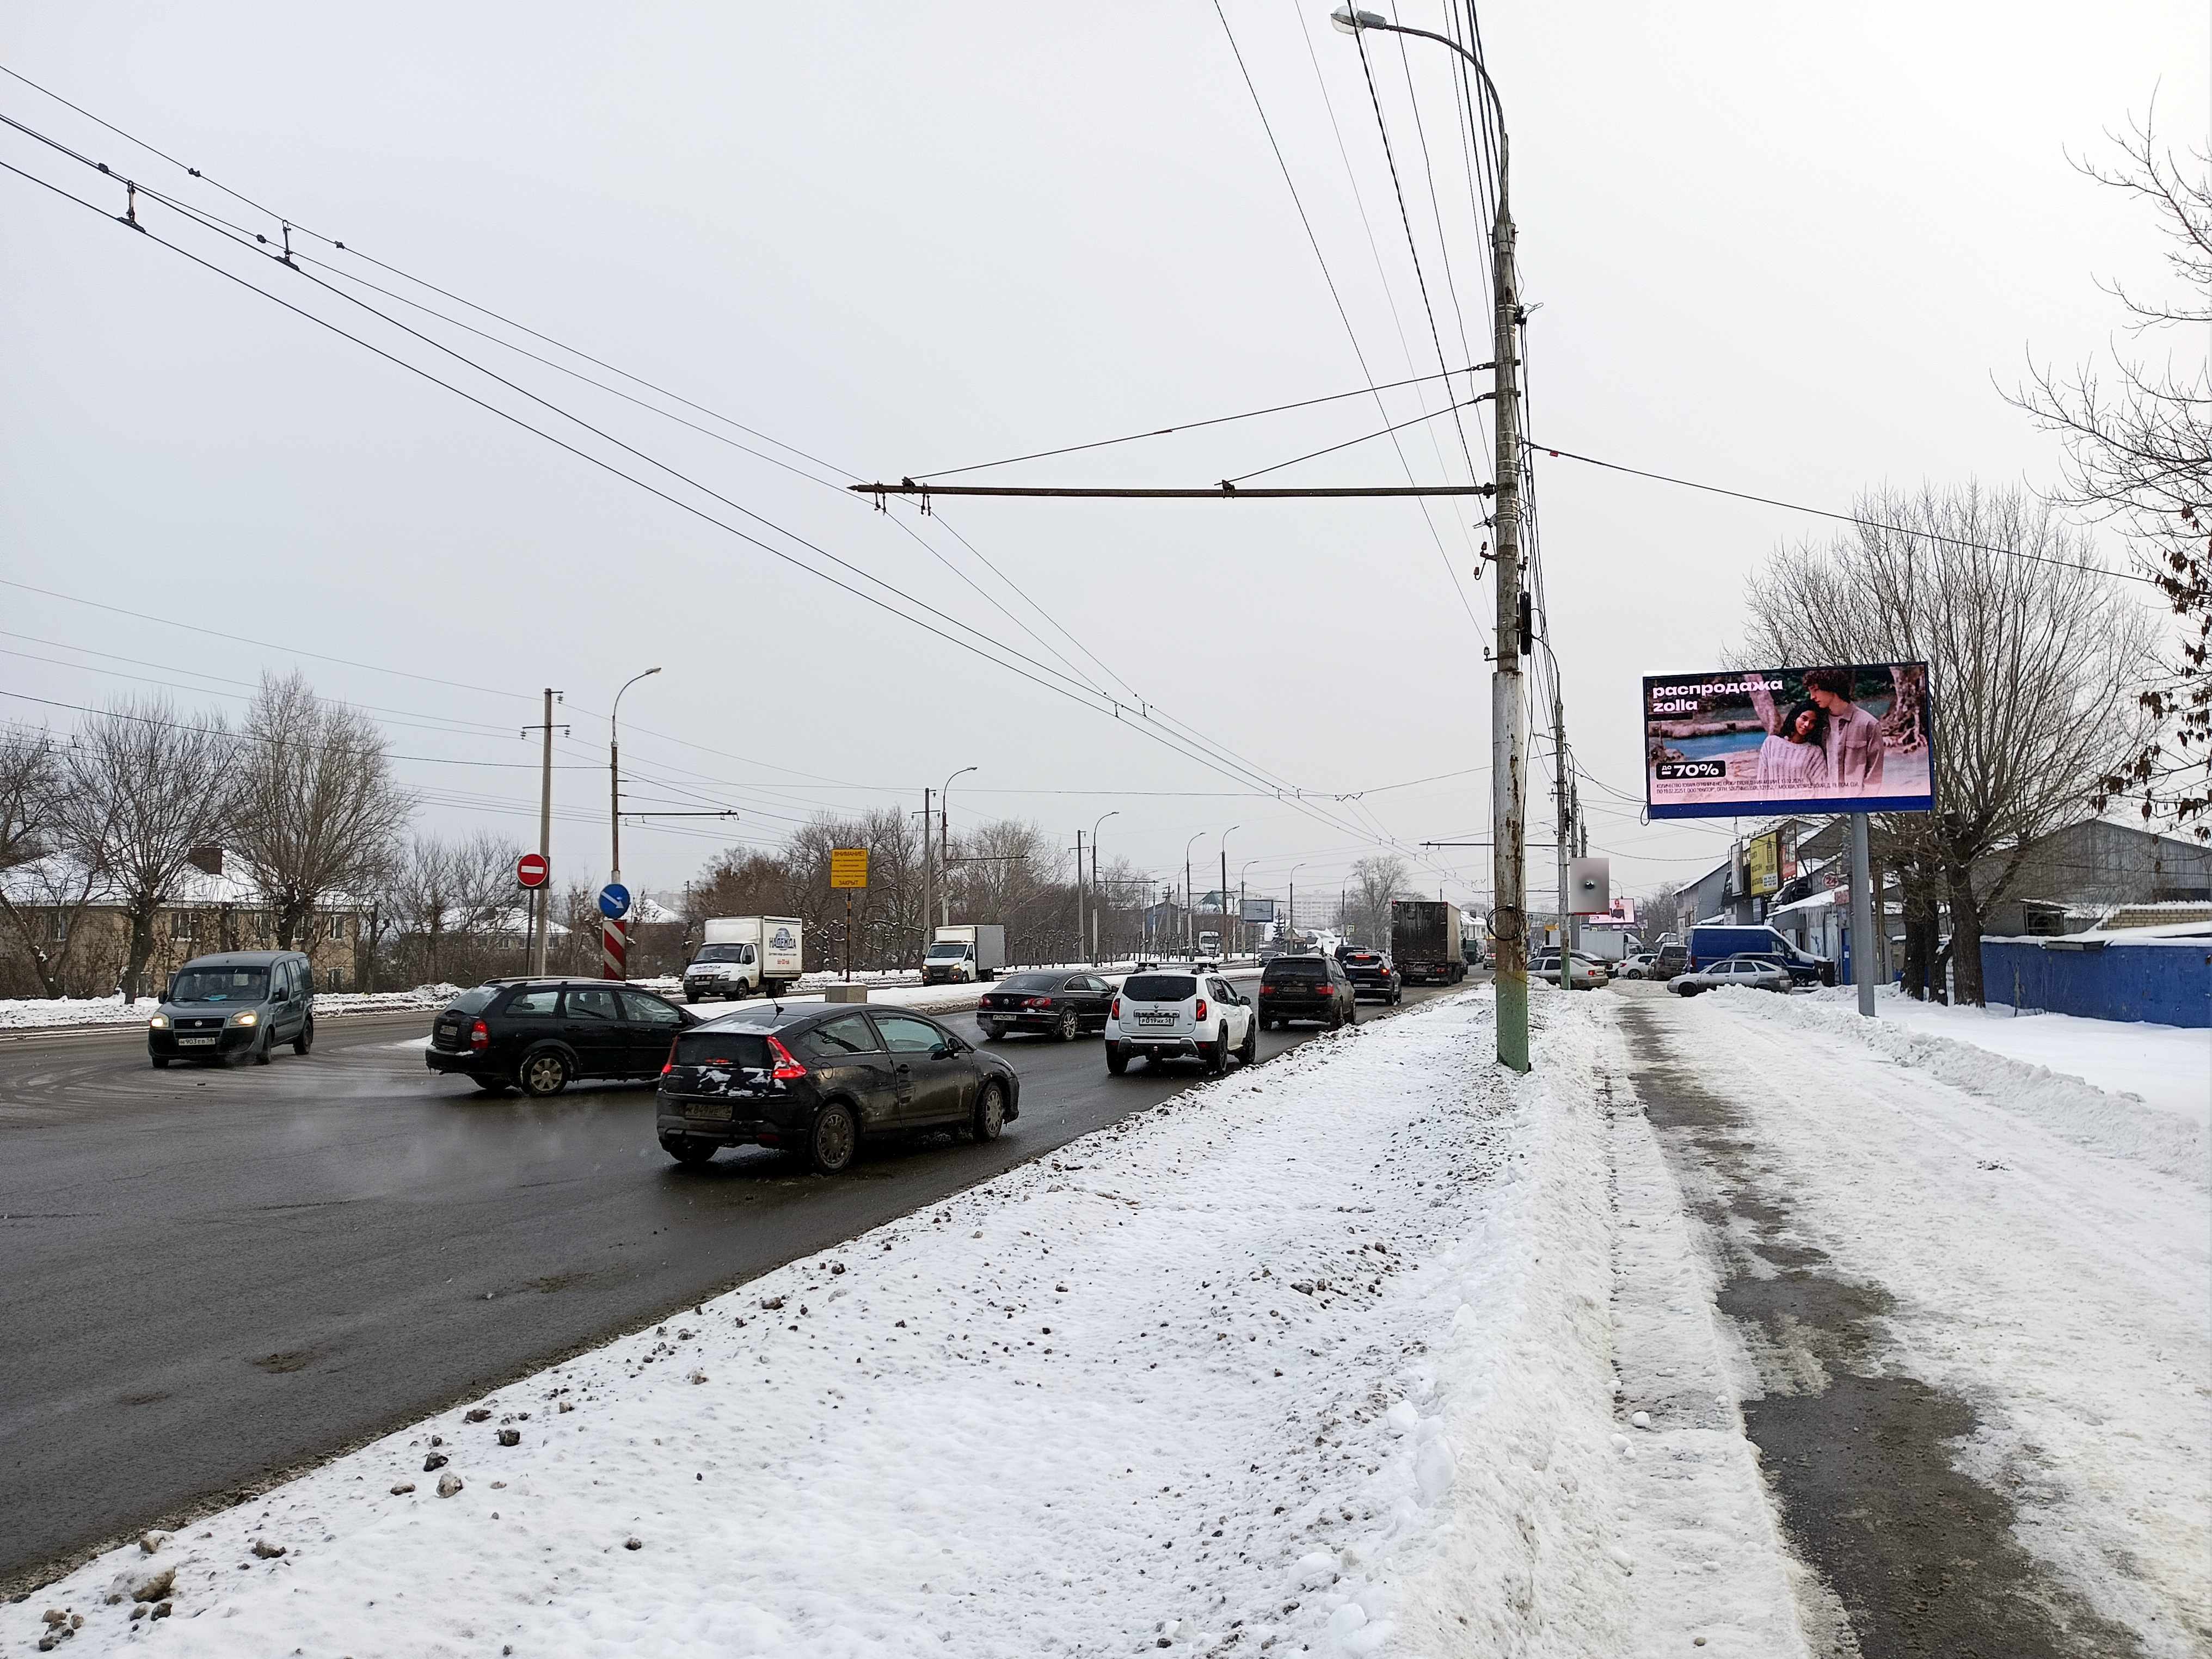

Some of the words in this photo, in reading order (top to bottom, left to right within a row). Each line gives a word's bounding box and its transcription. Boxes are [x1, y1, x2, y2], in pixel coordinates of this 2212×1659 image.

[1652, 680, 1783, 699] распродажа
[1653, 699, 1698, 712] zolla
[769, 937, 796, 949] НАДЕЖДА
